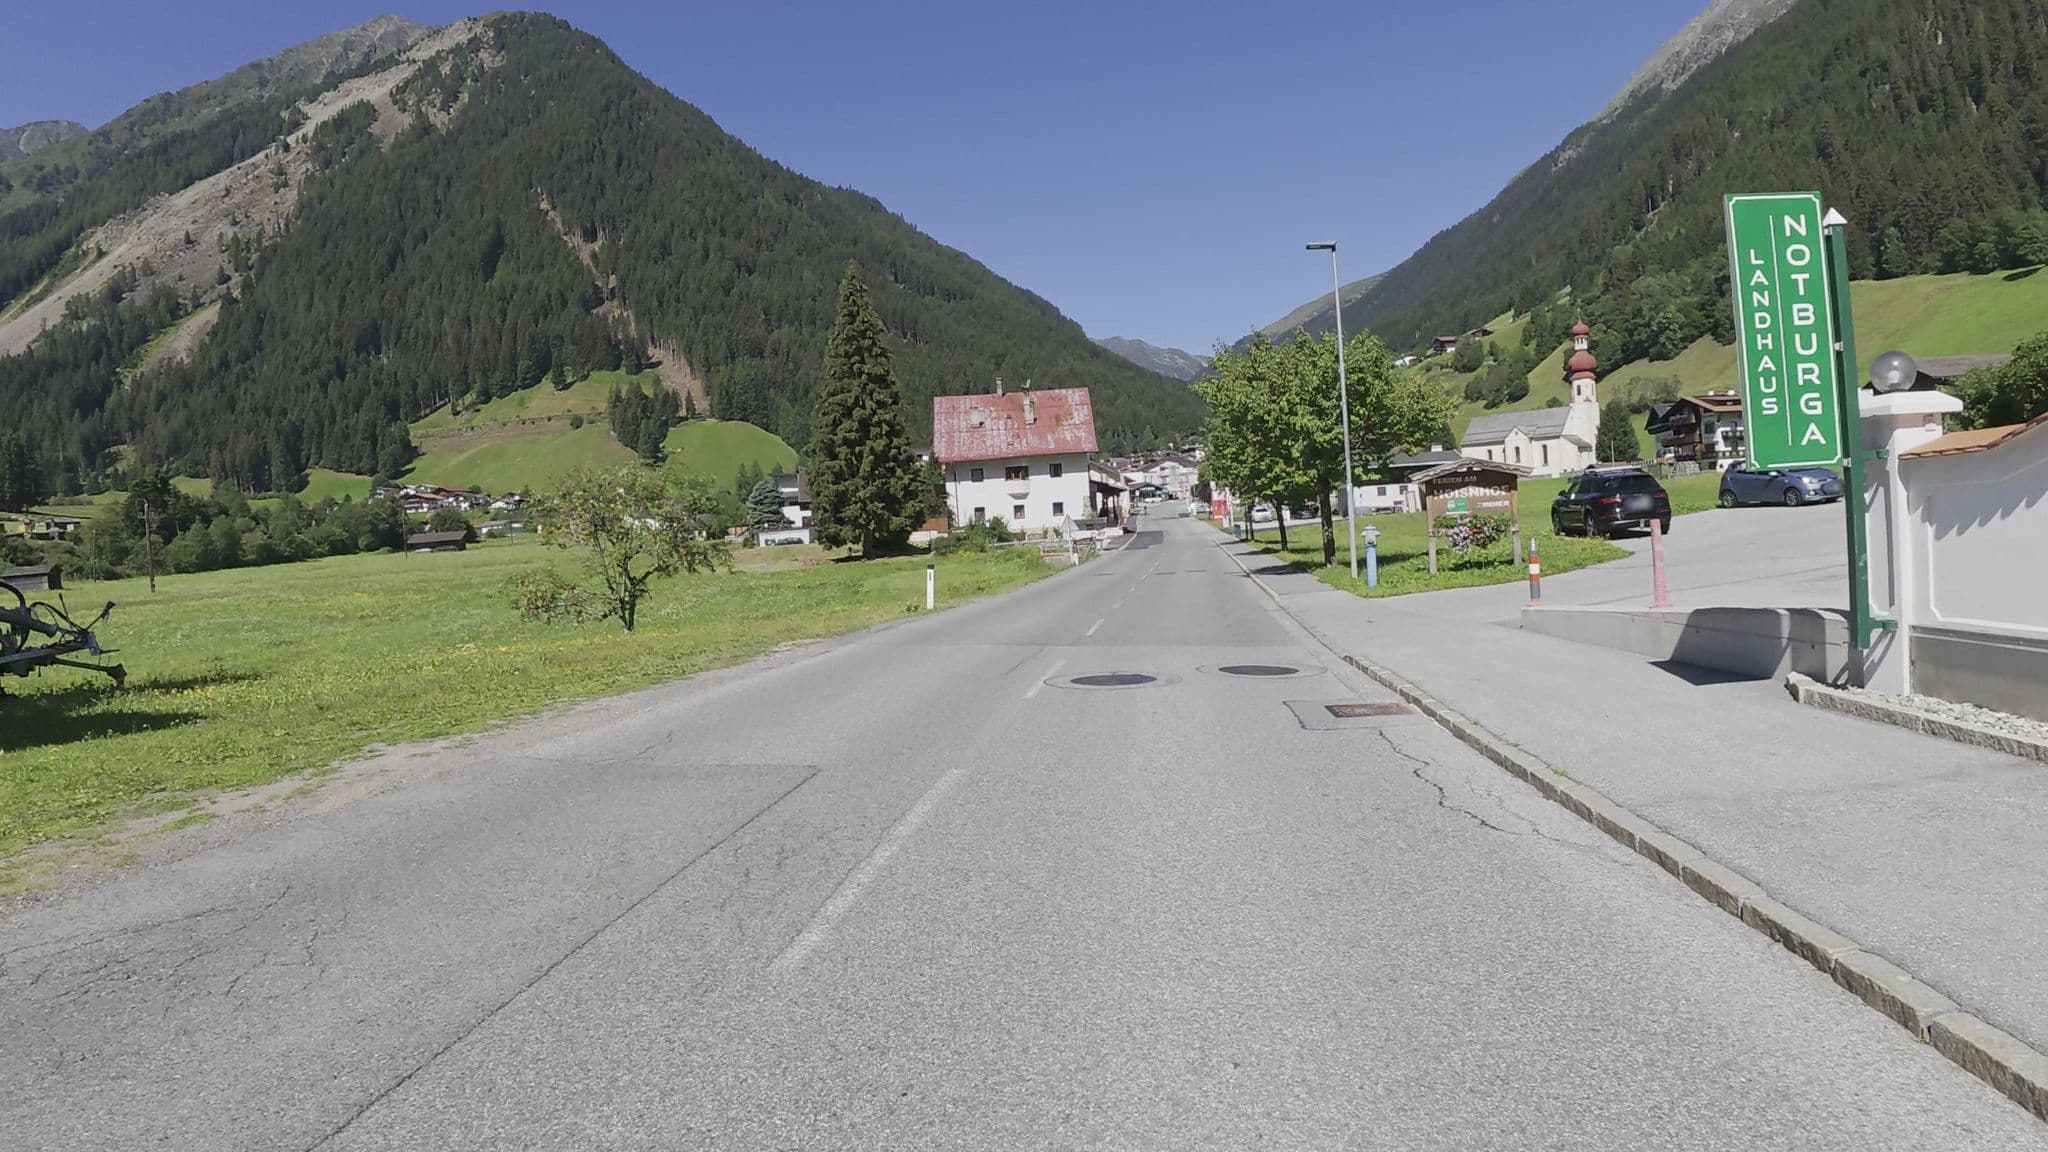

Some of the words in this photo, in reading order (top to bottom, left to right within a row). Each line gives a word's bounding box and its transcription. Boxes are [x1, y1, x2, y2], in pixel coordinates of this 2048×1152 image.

[1750, 249, 1778, 415] LANDHAUS
[1784, 214, 1826, 446] NOTBURGA
[1433, 476, 1462, 484] FERIEN
